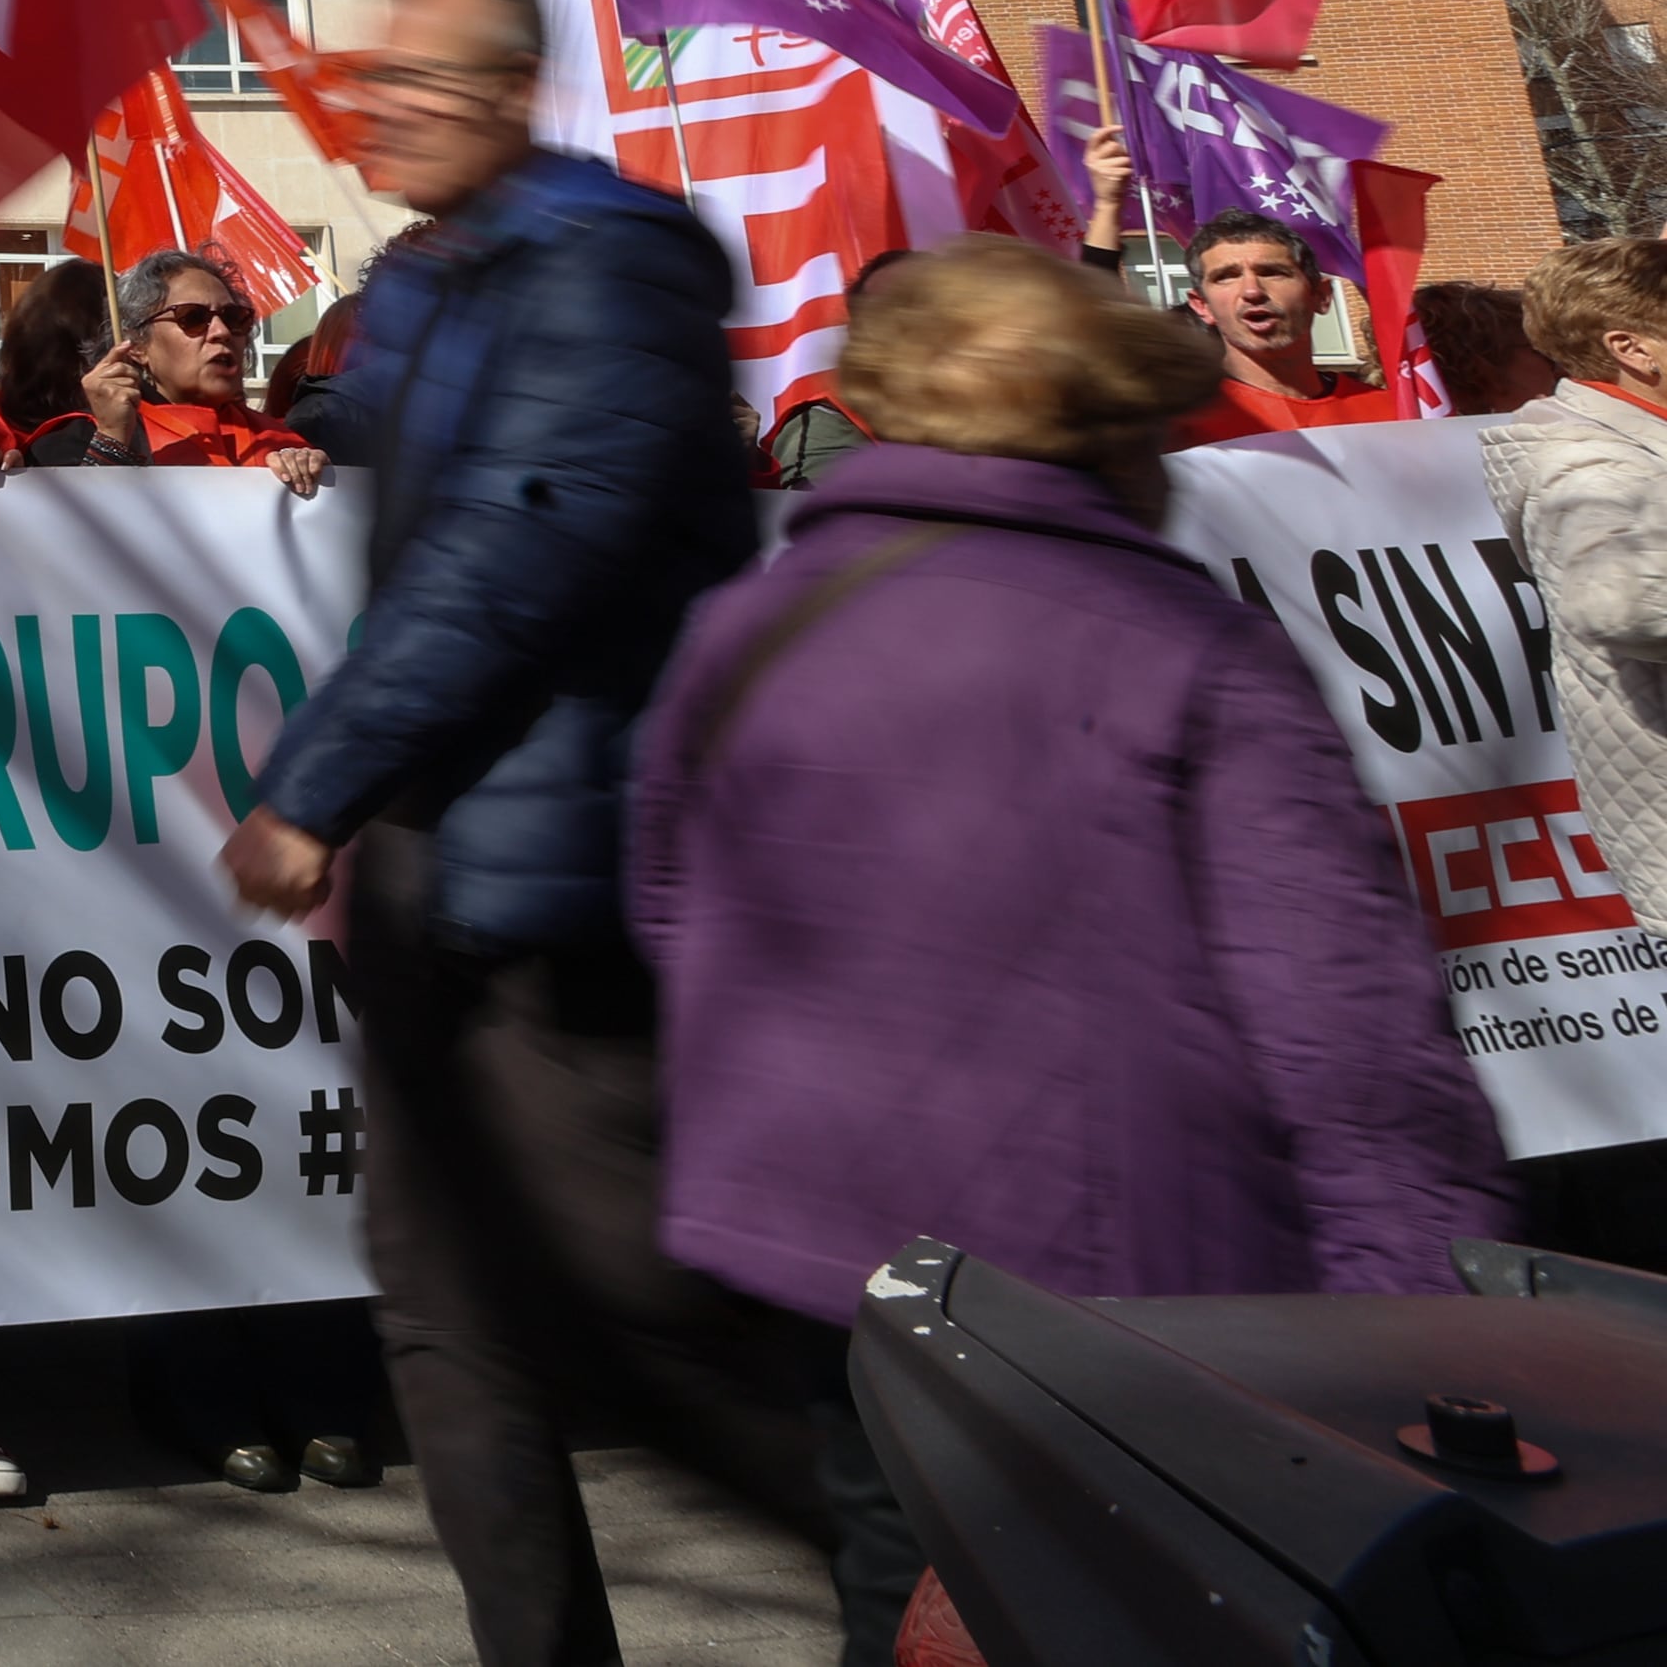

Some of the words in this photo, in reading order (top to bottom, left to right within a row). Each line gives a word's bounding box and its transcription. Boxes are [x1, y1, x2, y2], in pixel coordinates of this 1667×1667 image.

[1310, 542, 1516, 755] SIN
[1501, 947, 1550, 986] de
[1611, 997, 1660, 1039] de
